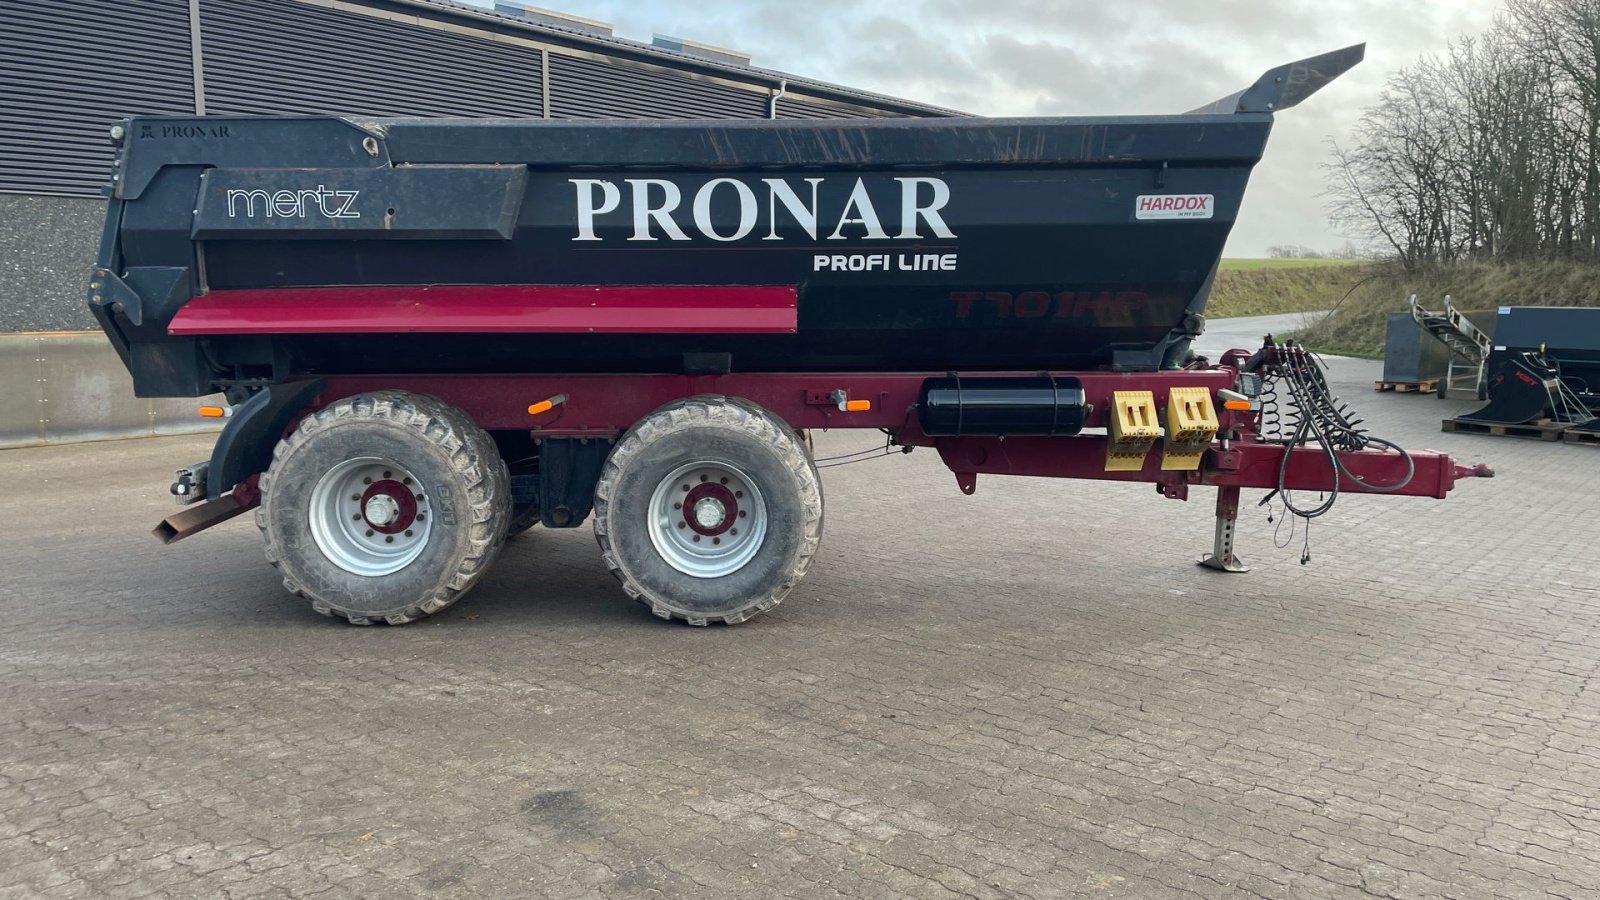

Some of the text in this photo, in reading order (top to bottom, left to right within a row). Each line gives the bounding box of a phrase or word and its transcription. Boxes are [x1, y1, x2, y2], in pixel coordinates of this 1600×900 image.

[162, 125, 231, 138] PRONAR
[227, 185, 360, 219] mertz
[568, 177, 957, 242] PRONAR
[1140, 197, 1208, 211] HARDOX
[814, 254, 889, 271] PROFI
